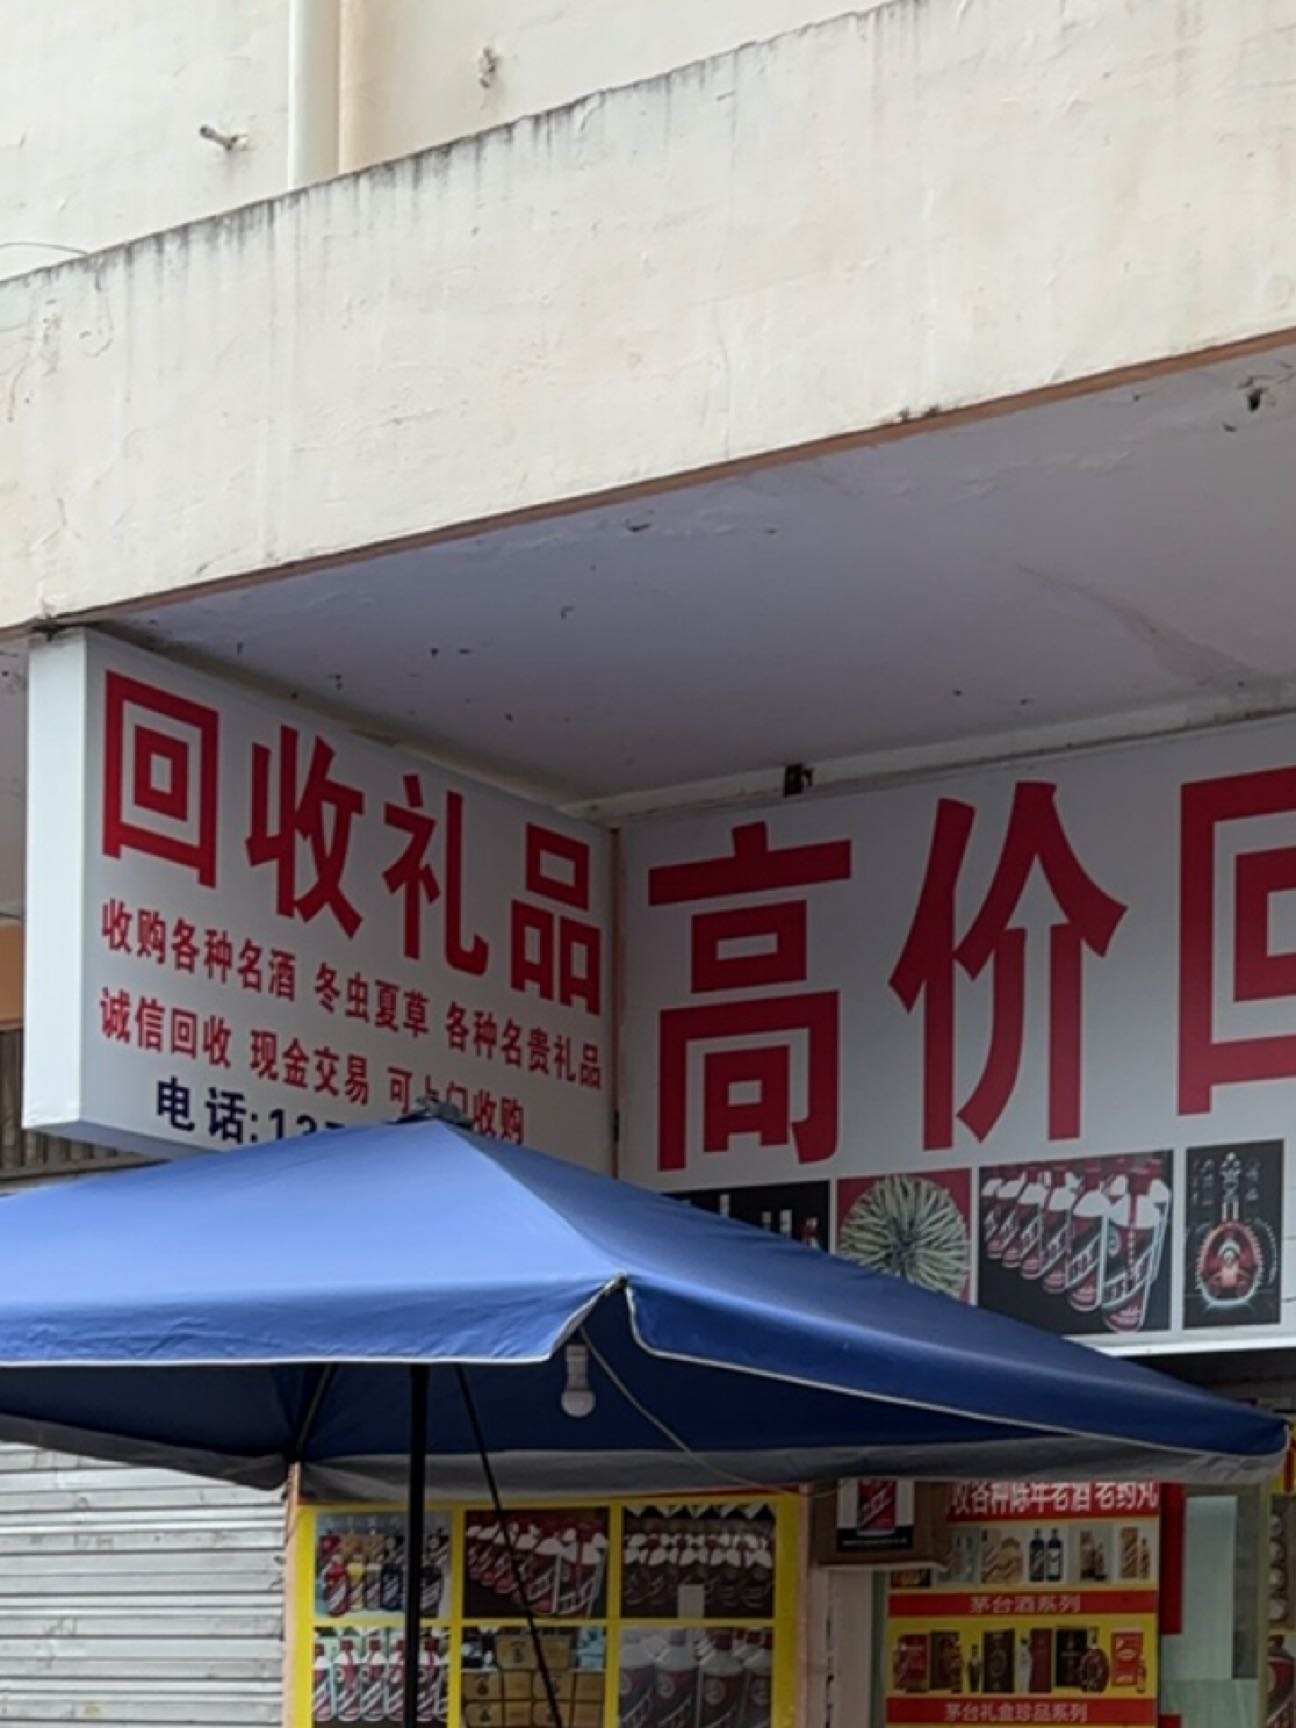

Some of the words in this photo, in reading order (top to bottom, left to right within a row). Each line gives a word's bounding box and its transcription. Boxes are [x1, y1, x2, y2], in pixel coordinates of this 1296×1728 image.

[102, 670, 602, 1016] 回收礼品
[100, 986, 233, 1069] 诚信回收
[249, 1029, 370, 1107] 现金交易
[101, 898, 297, 1002] 收购各种名酒
[313, 961, 430, 1038] 冬虫夏草
[445, 1000, 602, 1090] 各种名贵礼品
